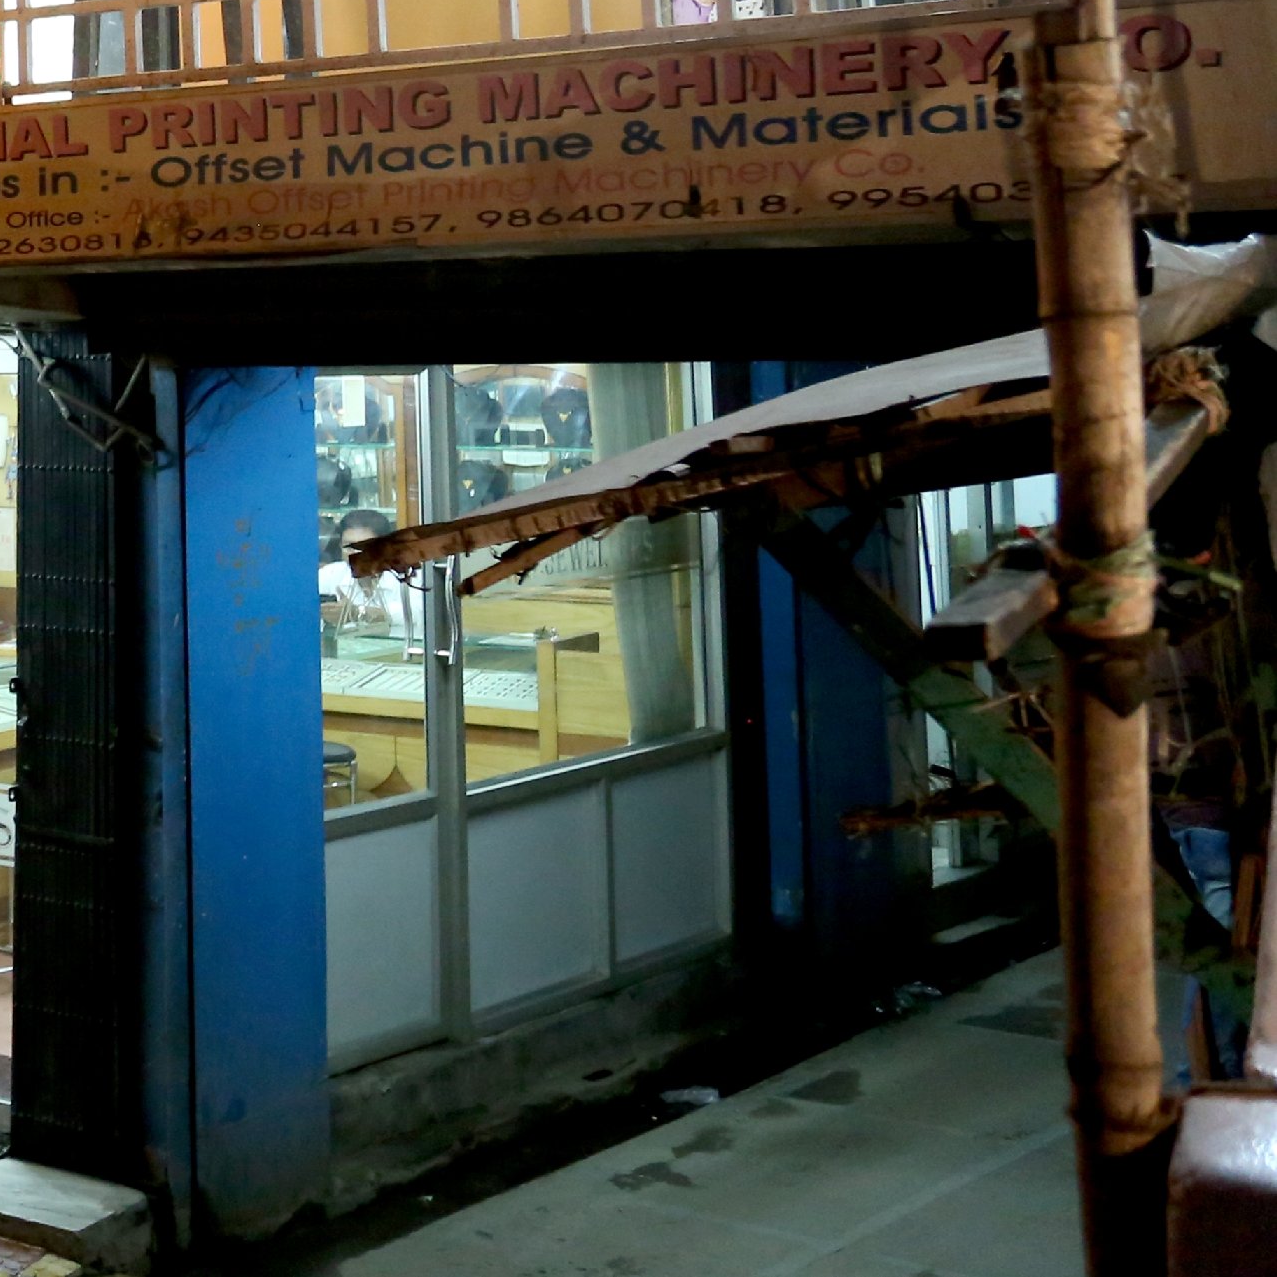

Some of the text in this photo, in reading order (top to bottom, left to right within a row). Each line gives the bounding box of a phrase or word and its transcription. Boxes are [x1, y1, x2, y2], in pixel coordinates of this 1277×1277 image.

[108, 81, 453, 154] PRINTING
[478, 30, 1011, 124] MACHINERY
[6, 209, 84, 229] Office
[555, 154, 816, 198] Machinery
[38, 168, 78, 194] in
[150, 148, 305, 188] Offset
[327, 130, 592, 177] Machine
[621, 120, 664, 156] &
[692, 95, 1023, 151] Materials
